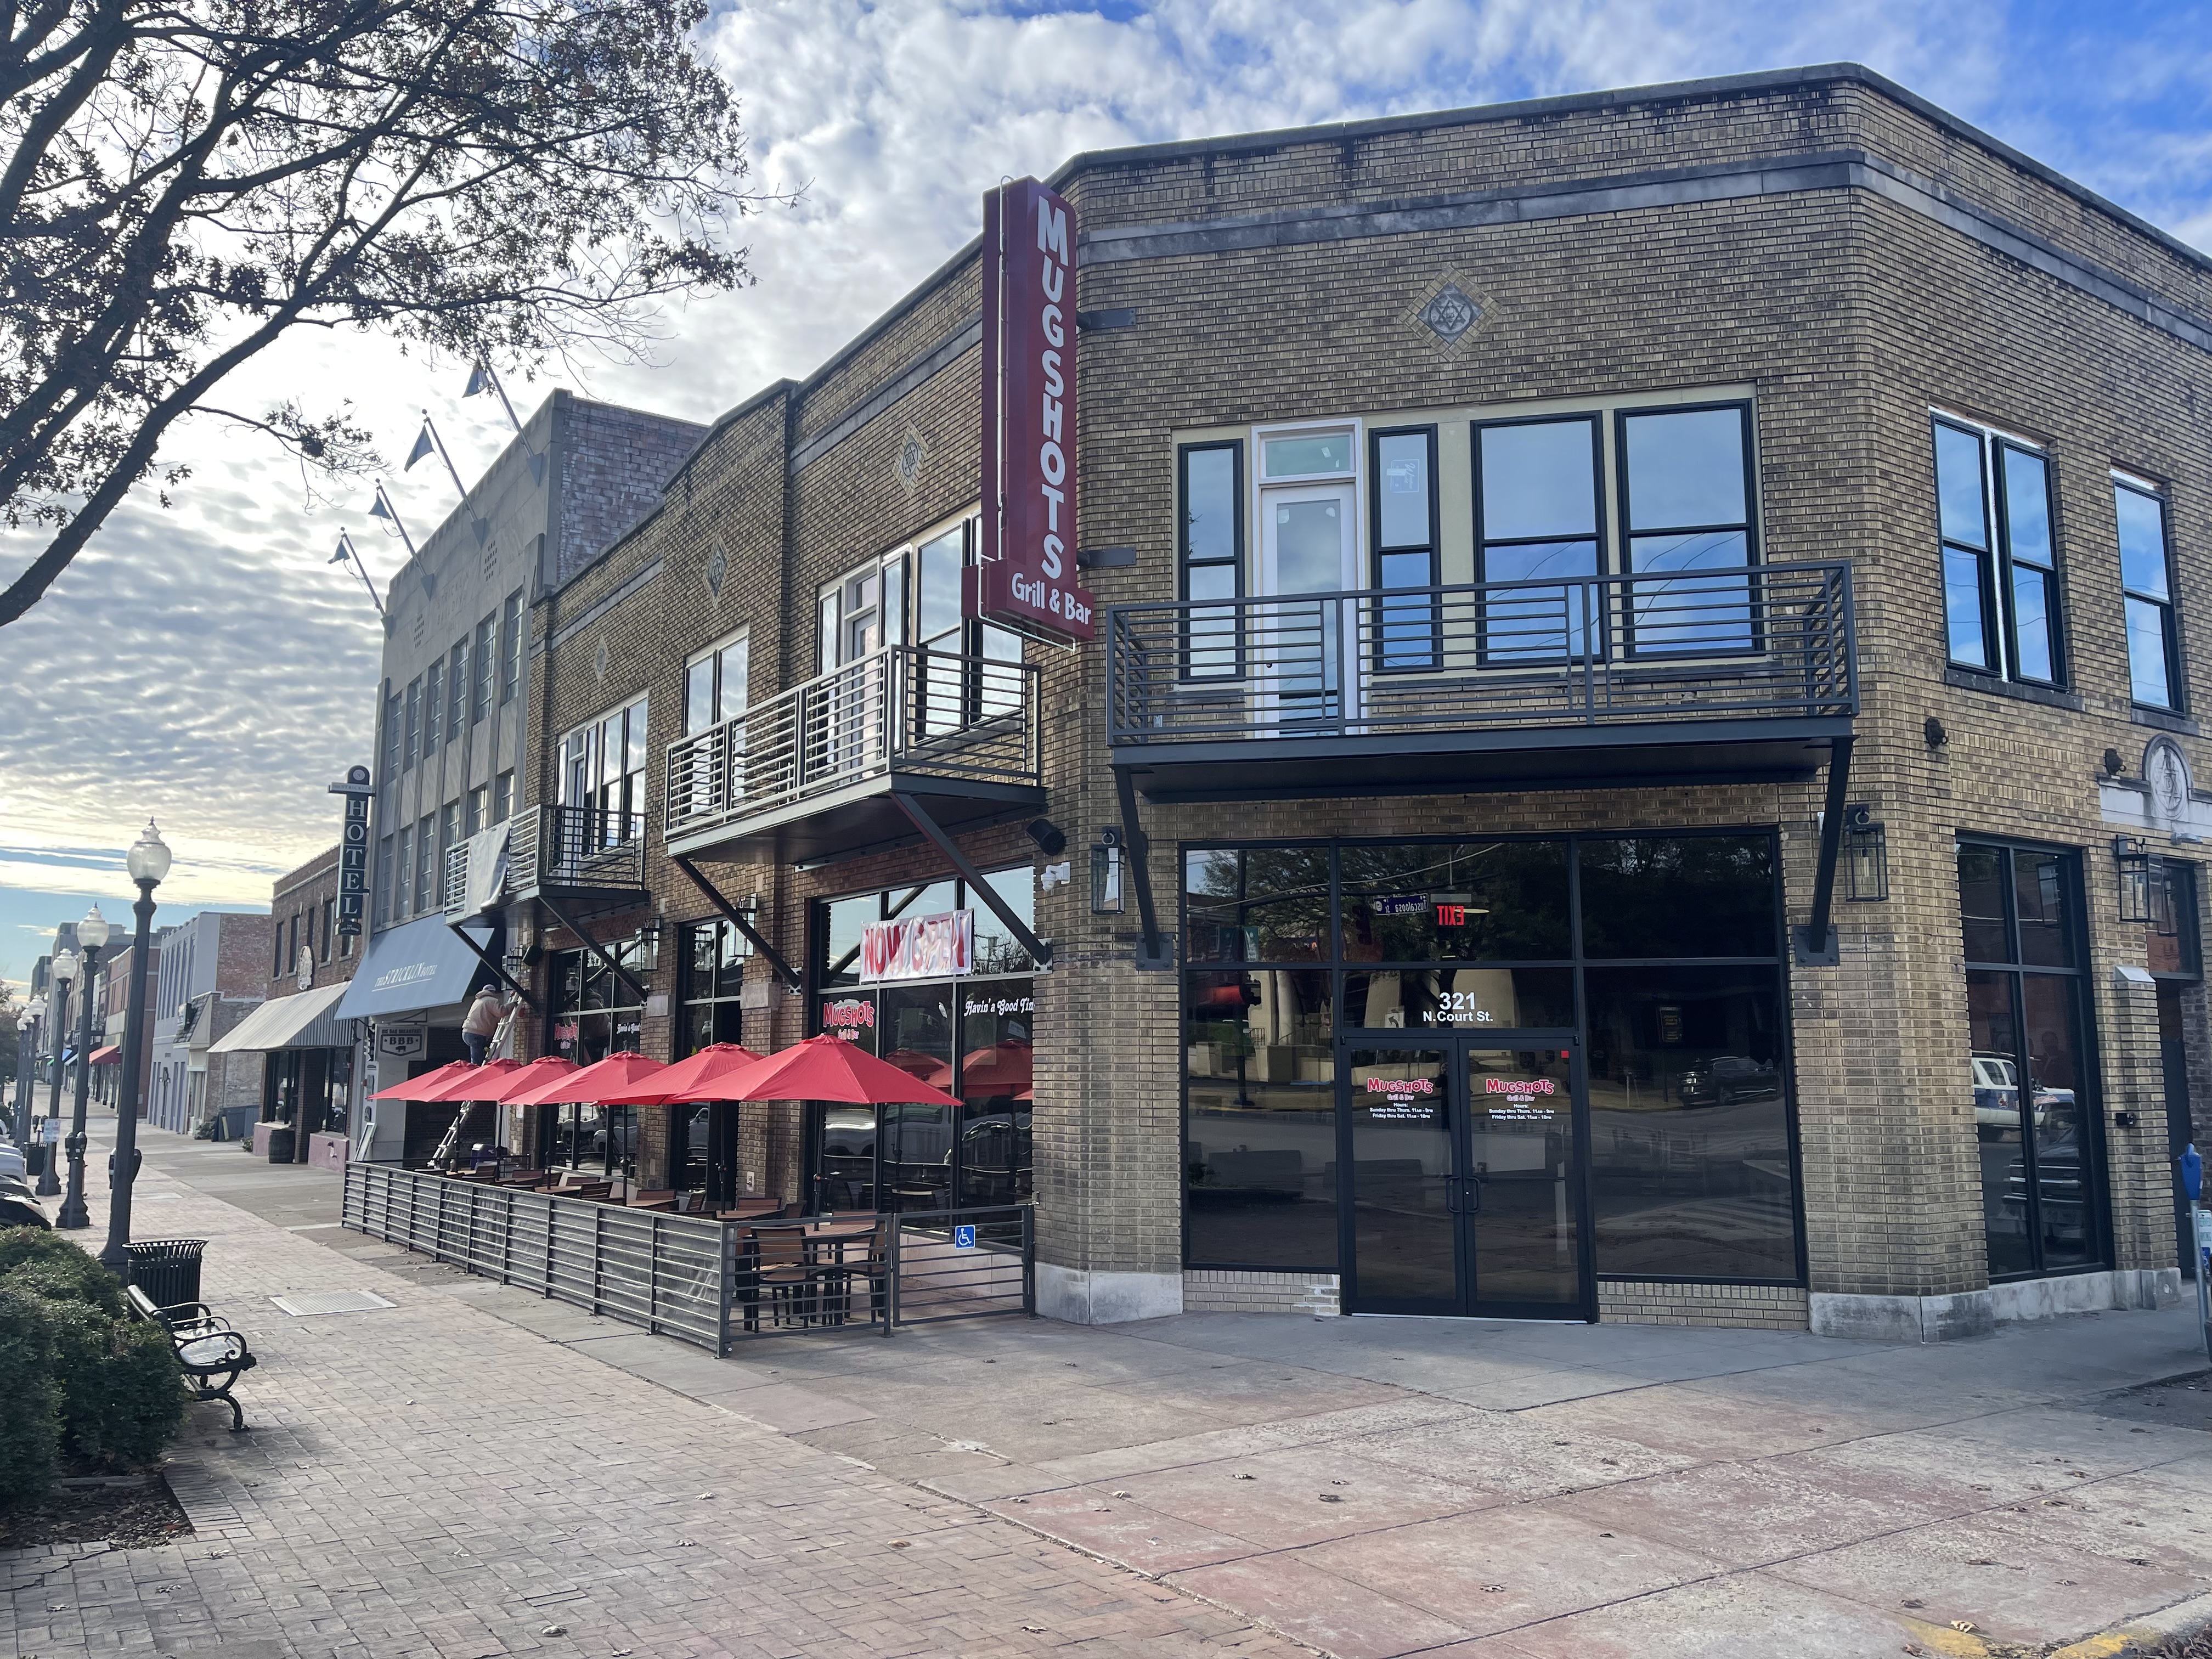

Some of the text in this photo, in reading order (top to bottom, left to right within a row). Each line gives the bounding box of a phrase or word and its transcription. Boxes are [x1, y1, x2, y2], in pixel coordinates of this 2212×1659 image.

[1037, 195, 1069, 580] MUGSHOTS
[1011, 572, 1092, 625] Grill & Bar
[343, 799, 366, 915] HOTEL
[864, 916, 964, 975] NOW OPEN
[383, 962, 425, 985] STRICKLIN
[997, 998, 1019, 1016] Good
[1439, 992, 1475, 1010] 321
[823, 1001, 875, 1028] MUGSHOTS
[1423, 1011, 1493, 1022] N. Court St.
[851, 1029, 859, 1040] Bar
[1367, 1077, 1434, 1093] MUGSHOTS
[1486, 1079, 1555, 1094] MUGSHOTS
